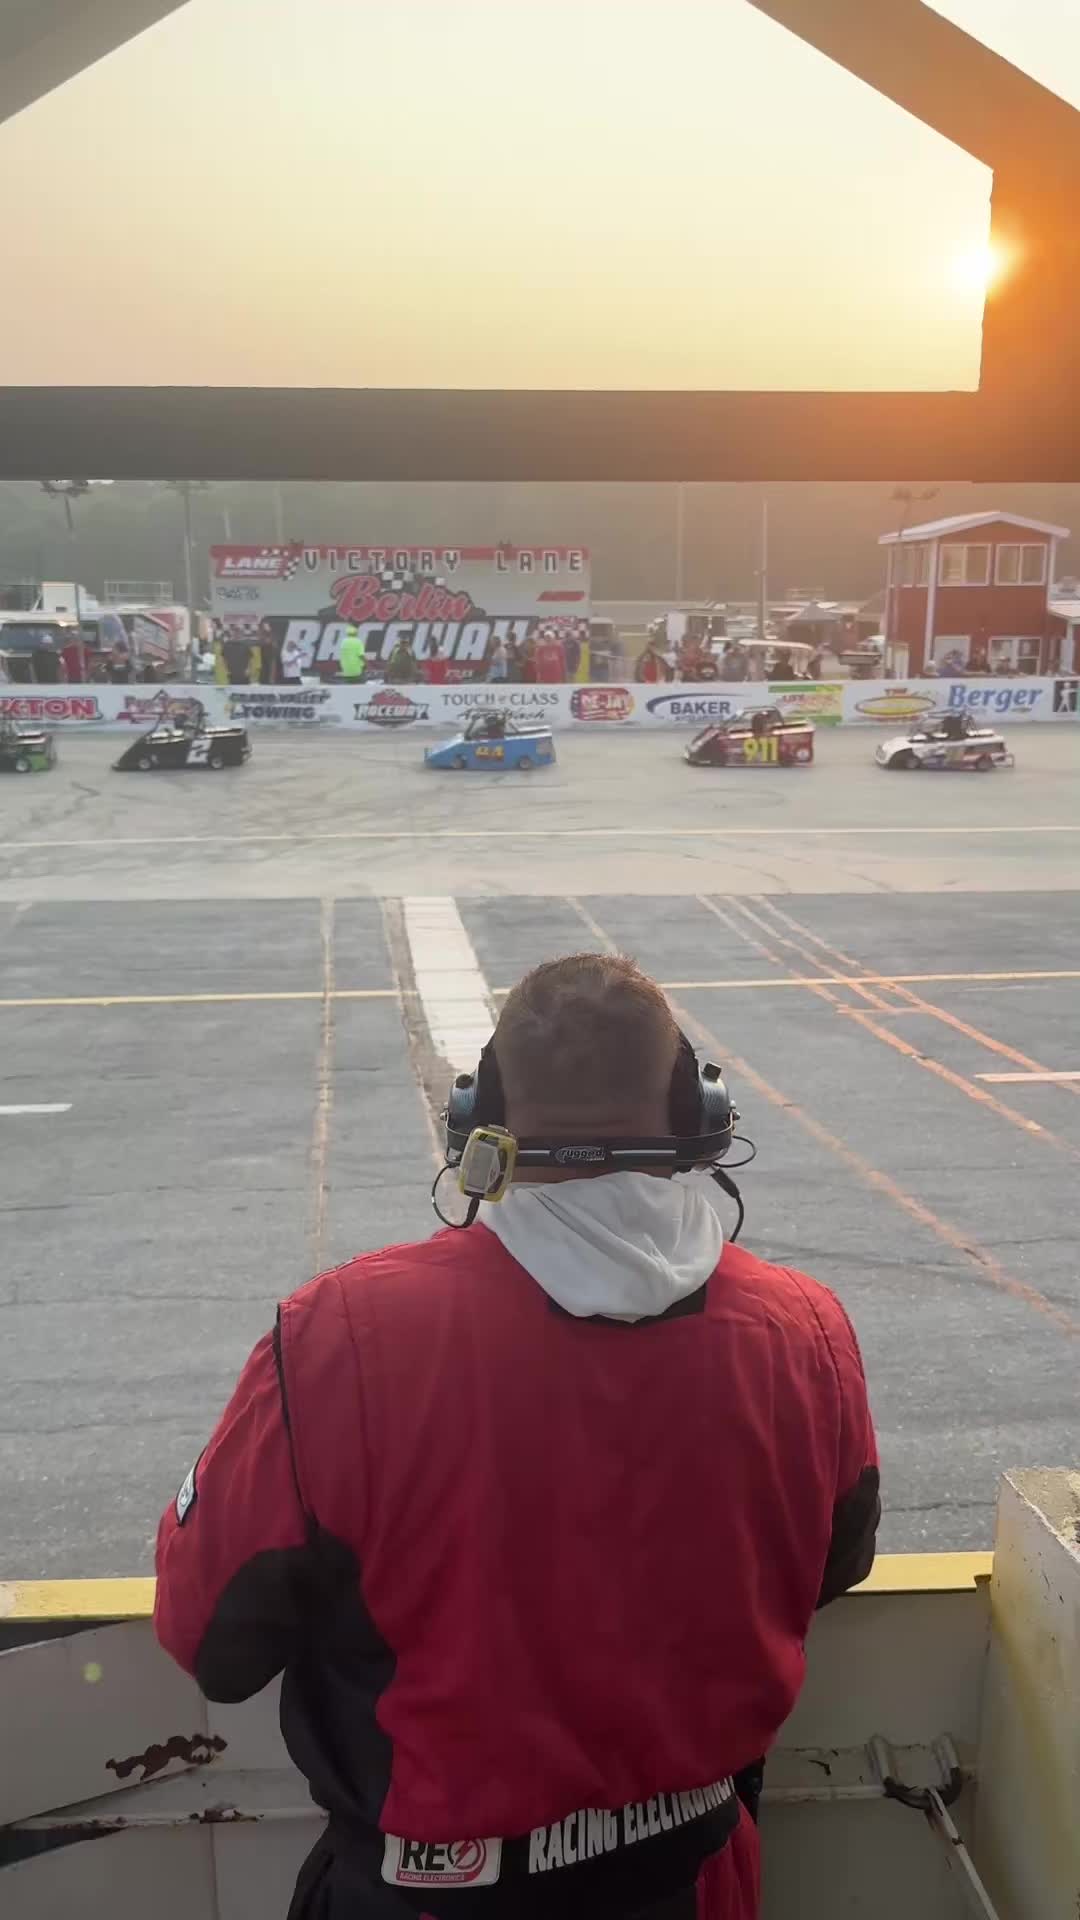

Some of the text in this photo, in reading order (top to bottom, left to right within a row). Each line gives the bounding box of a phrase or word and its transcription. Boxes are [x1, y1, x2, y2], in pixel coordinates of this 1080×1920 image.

[304, 550, 584, 574] VICTORY LANE
[332, 576, 473, 621] Berlin
[242, 704, 316, 719] TOWING
[441, 693, 495, 706] TOUCH
[509, 692, 559, 706] CLASS
[670, 702, 732, 715] BAKER
[948, 684, 1043, 713] Berger
[186, 738, 212, 764] 2
[743, 736, 779, 763] 911
[529, 1807, 618, 1874] RACING
